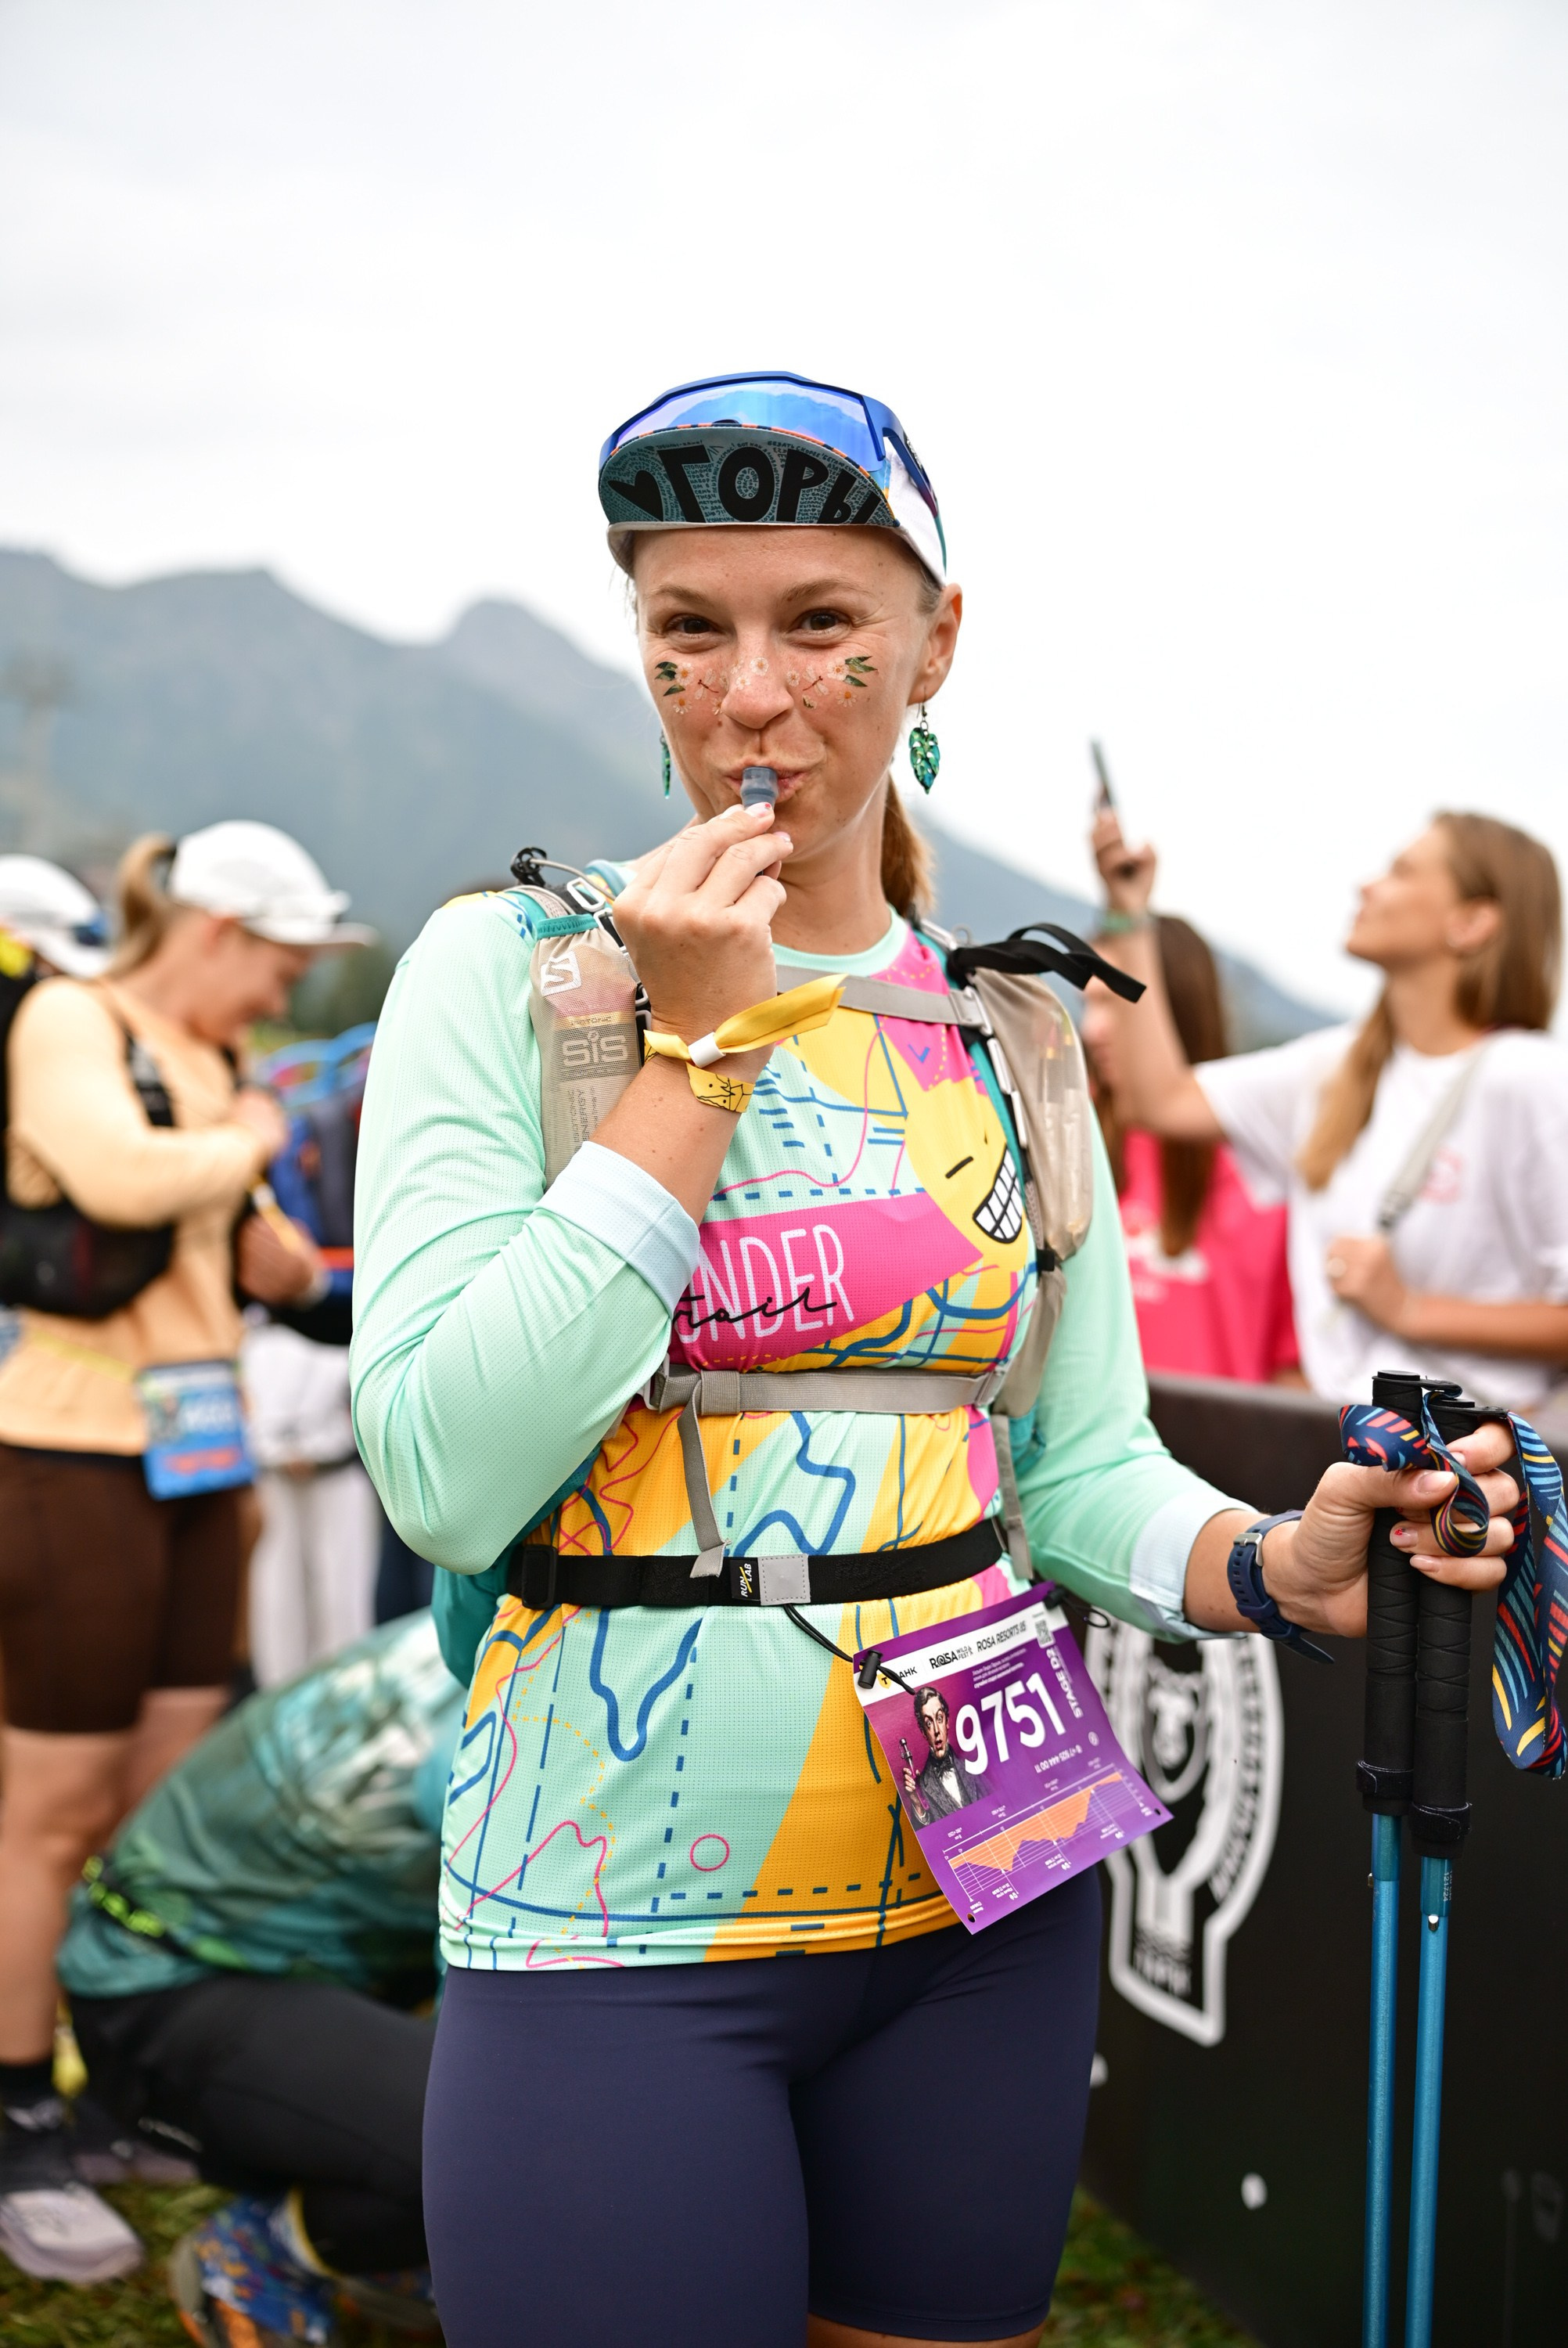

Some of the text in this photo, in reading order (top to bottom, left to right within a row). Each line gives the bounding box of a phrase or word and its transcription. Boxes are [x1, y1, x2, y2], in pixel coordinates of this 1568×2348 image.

[739, 1576, 749, 1597] RUN
[976, 1635, 996, 1652] ROSA
[929, 1651, 958, 1669] ROSA
[899, 1666, 918, 1679] АНК
[955, 1672, 1066, 1775] 9751
